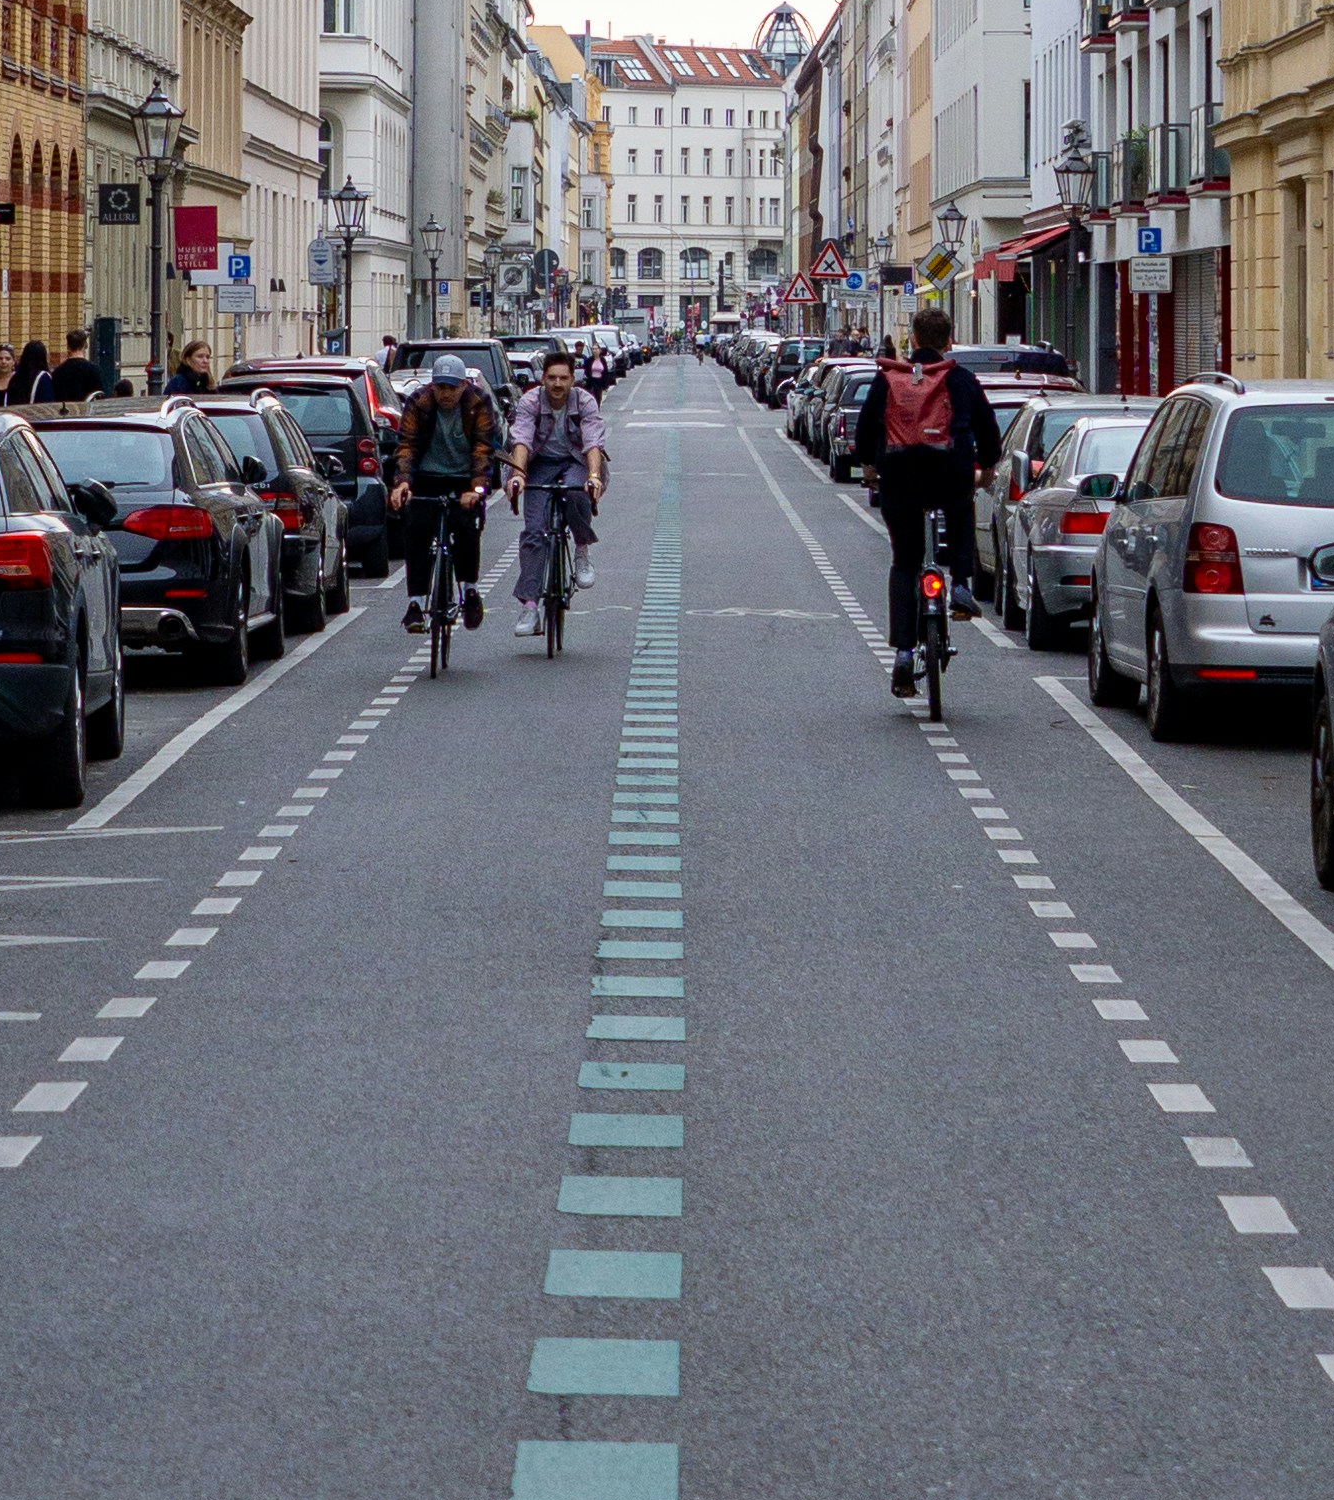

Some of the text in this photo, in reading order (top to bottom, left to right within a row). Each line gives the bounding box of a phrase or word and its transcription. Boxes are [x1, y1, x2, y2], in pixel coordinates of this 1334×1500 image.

[102, 213, 138, 223] ALLURE
[177, 246, 217, 254] MUSEUM
[177, 260, 209, 268] STILLE
